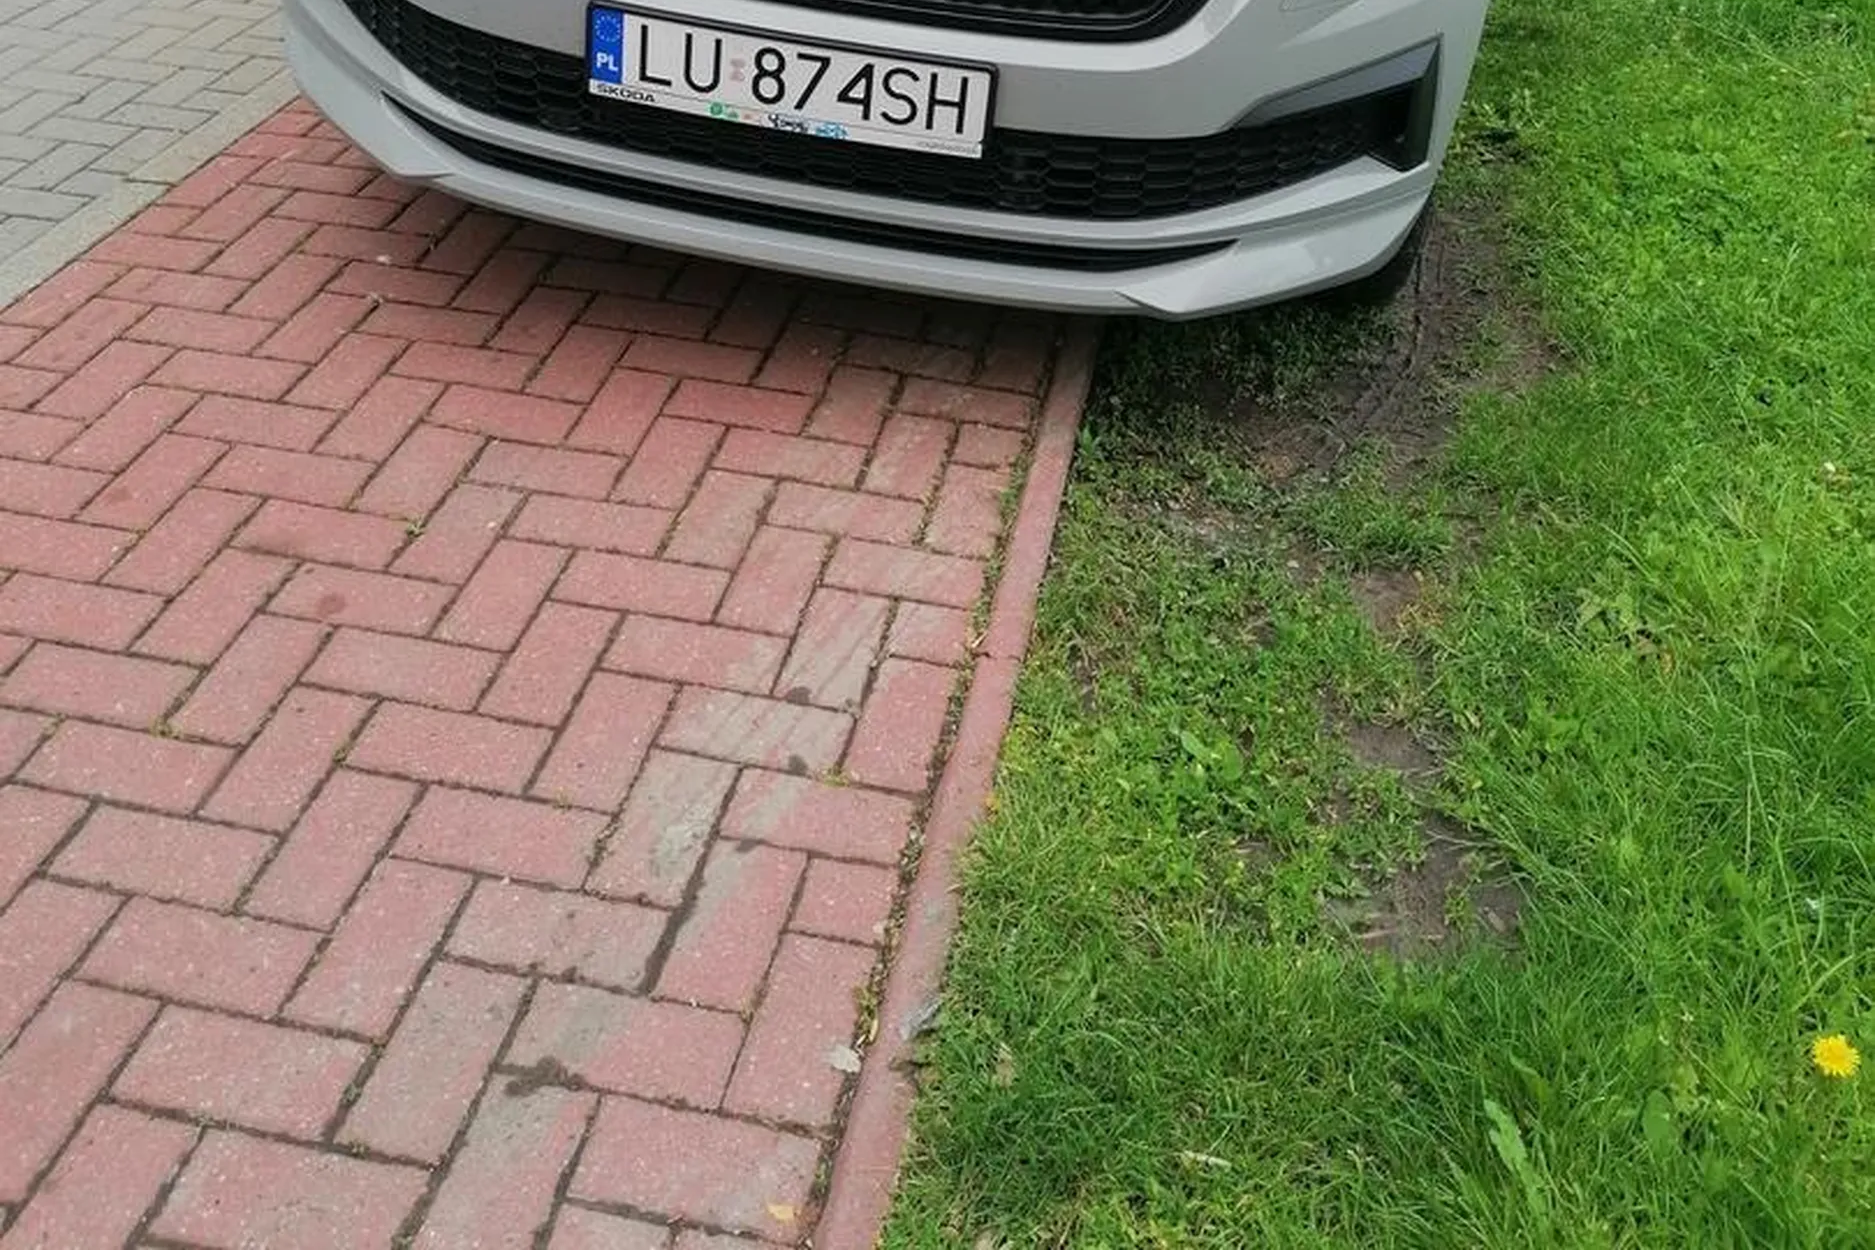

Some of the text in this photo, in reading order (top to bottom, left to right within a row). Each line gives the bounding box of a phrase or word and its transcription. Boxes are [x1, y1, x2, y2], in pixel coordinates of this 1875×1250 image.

[596, 52, 619, 72] PL
[639, 24, 969, 135] LU 874SH
